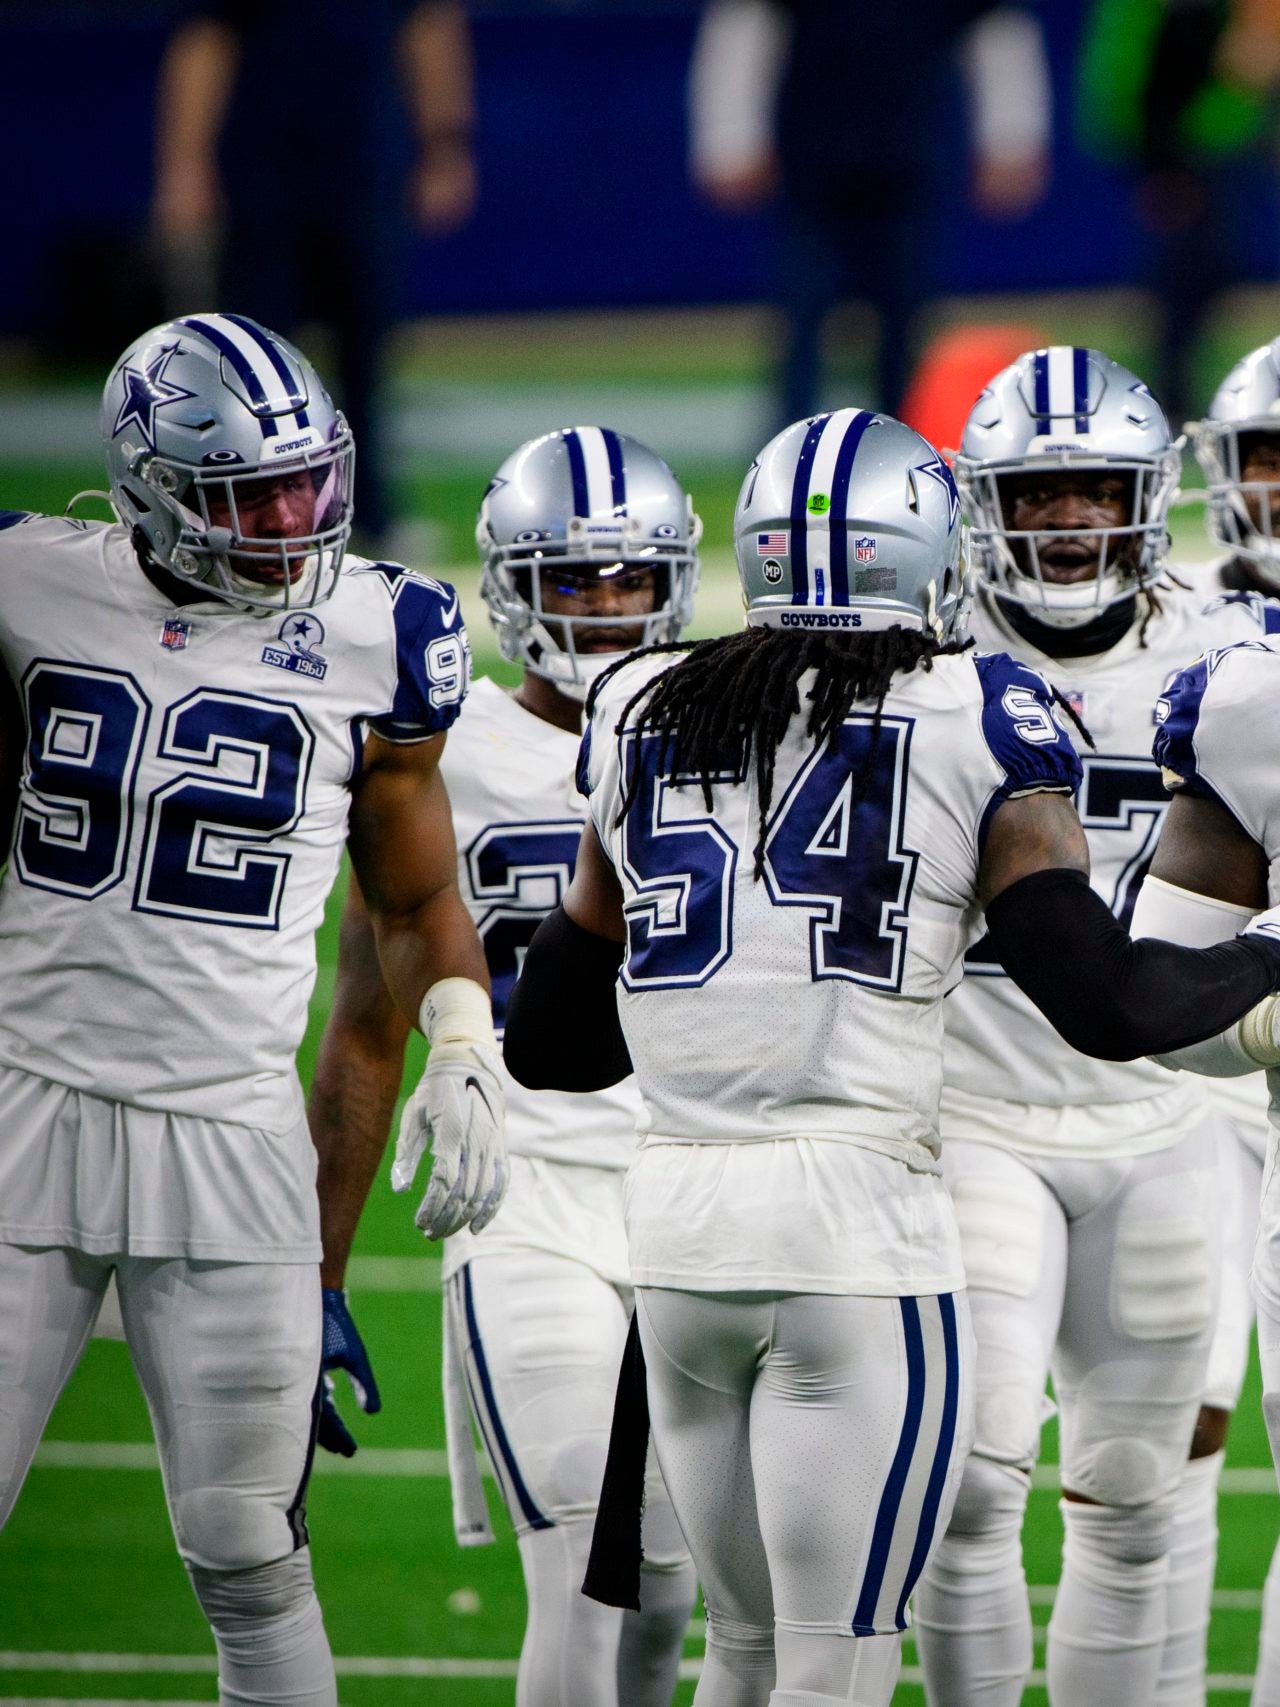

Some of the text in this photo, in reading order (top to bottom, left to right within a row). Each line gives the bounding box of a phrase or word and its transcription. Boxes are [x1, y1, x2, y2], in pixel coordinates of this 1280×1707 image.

[857, 548, 875, 560] NFL
[765, 565, 781, 578] MP
[781, 613, 862, 627] COWBOYS
[263, 650, 325, 678] EST. 1960
[14, 657, 316, 930] 92
[617, 712, 918, 993] 54
